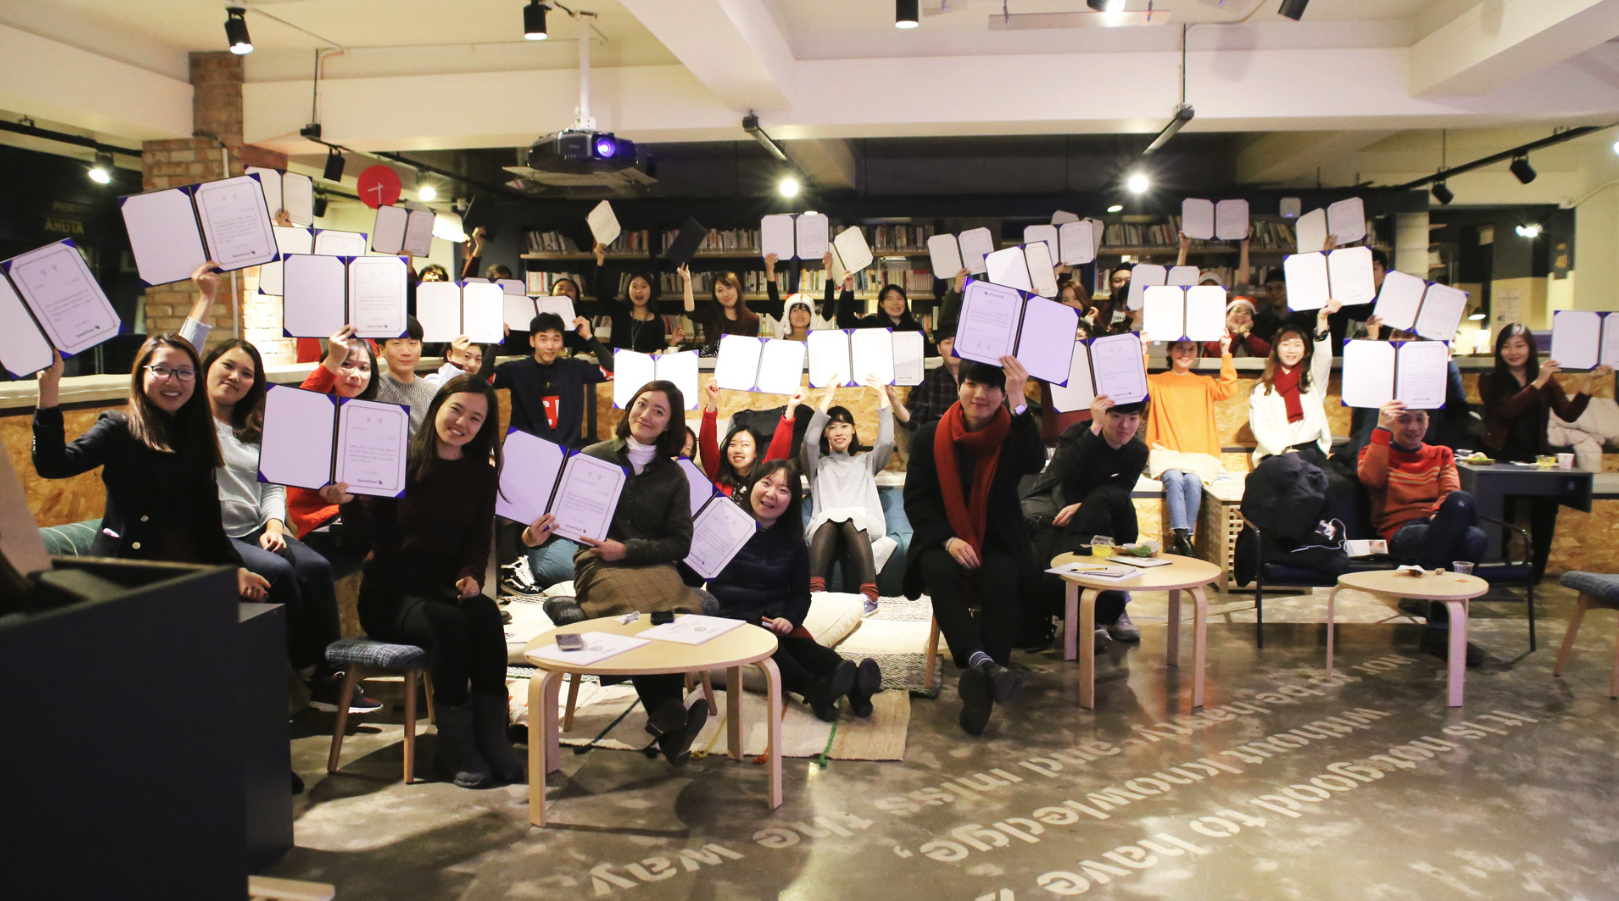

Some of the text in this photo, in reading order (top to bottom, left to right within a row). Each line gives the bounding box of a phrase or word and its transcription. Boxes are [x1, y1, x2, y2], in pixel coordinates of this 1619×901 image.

[1018, 740, 1122, 778] and
[873, 768, 1024, 817] miss
[893, 706, 1393, 863] without knowledge,
[1250, 761, 1385, 819] good
[752, 810, 875, 849] the
[1189, 808, 1267, 838] to
[1036, 832, 1208, 896] have
